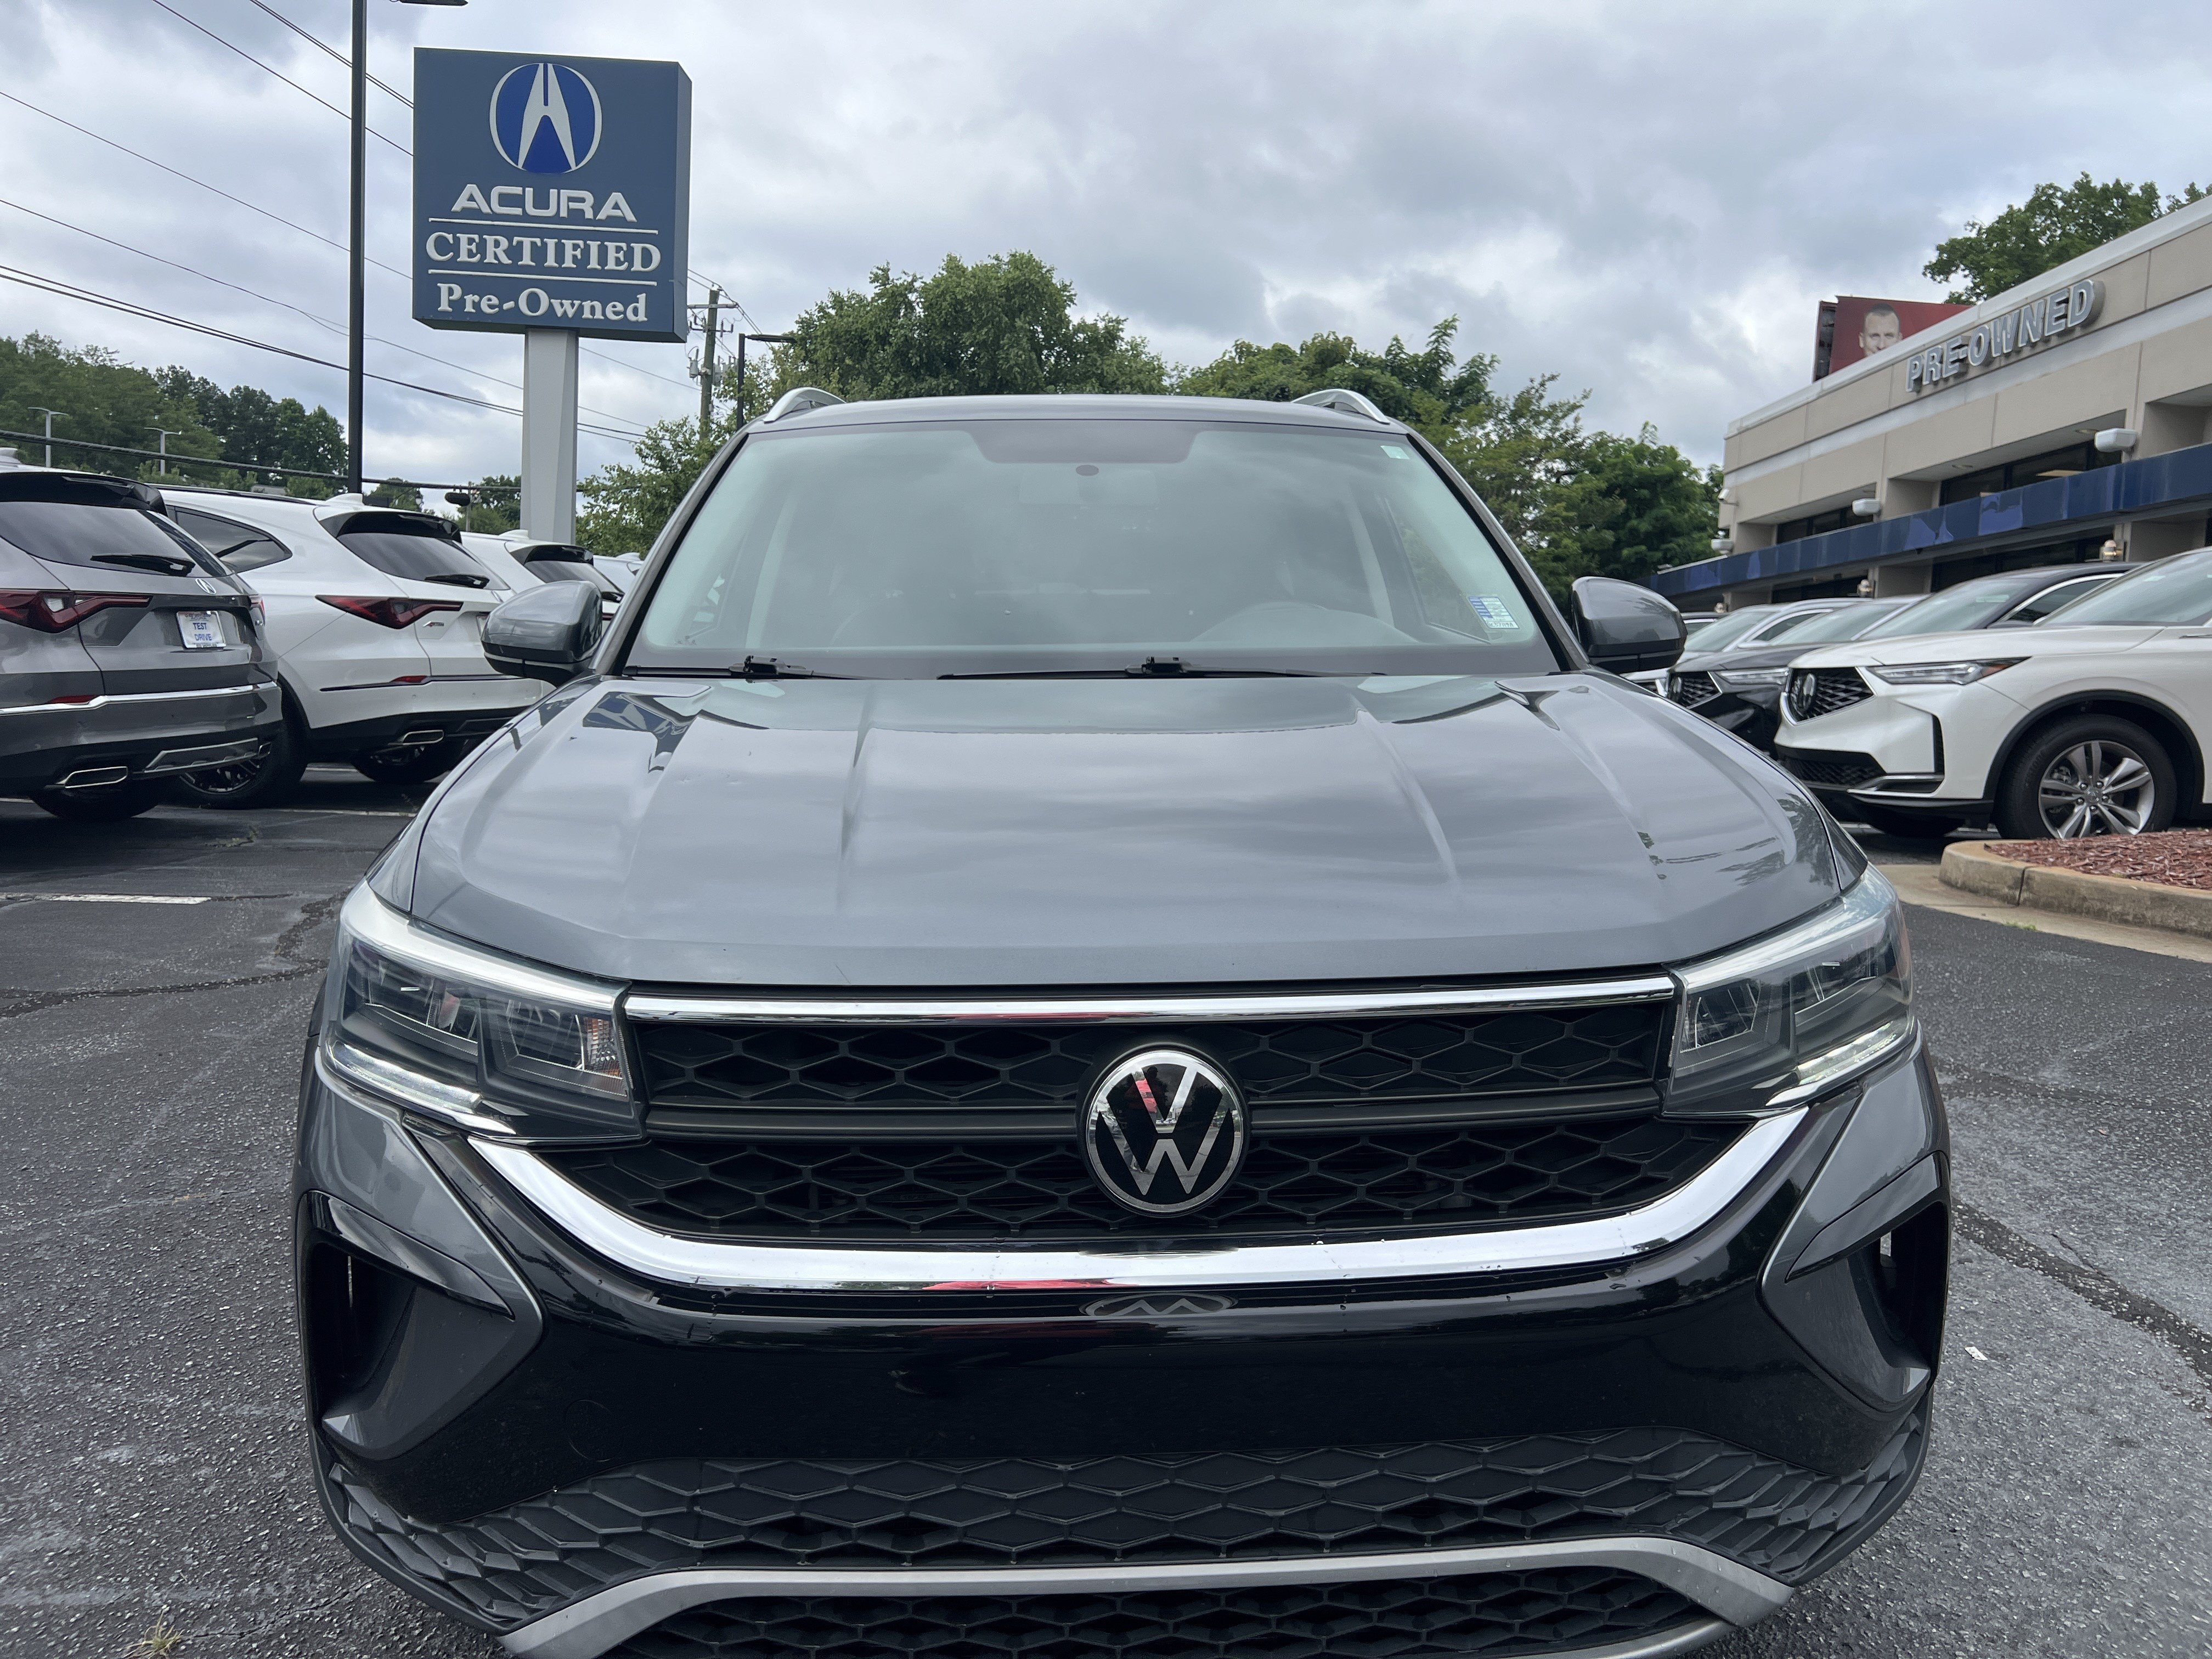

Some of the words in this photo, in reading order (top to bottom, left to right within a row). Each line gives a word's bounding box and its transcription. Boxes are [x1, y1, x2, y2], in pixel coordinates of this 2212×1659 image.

[451, 184, 637, 222] ACURA
[426, 232, 661, 272] CERTIFIED
[437, 283, 648, 322] Pre-Owned
[1906, 279, 2095, 392] PRE-OWNED
